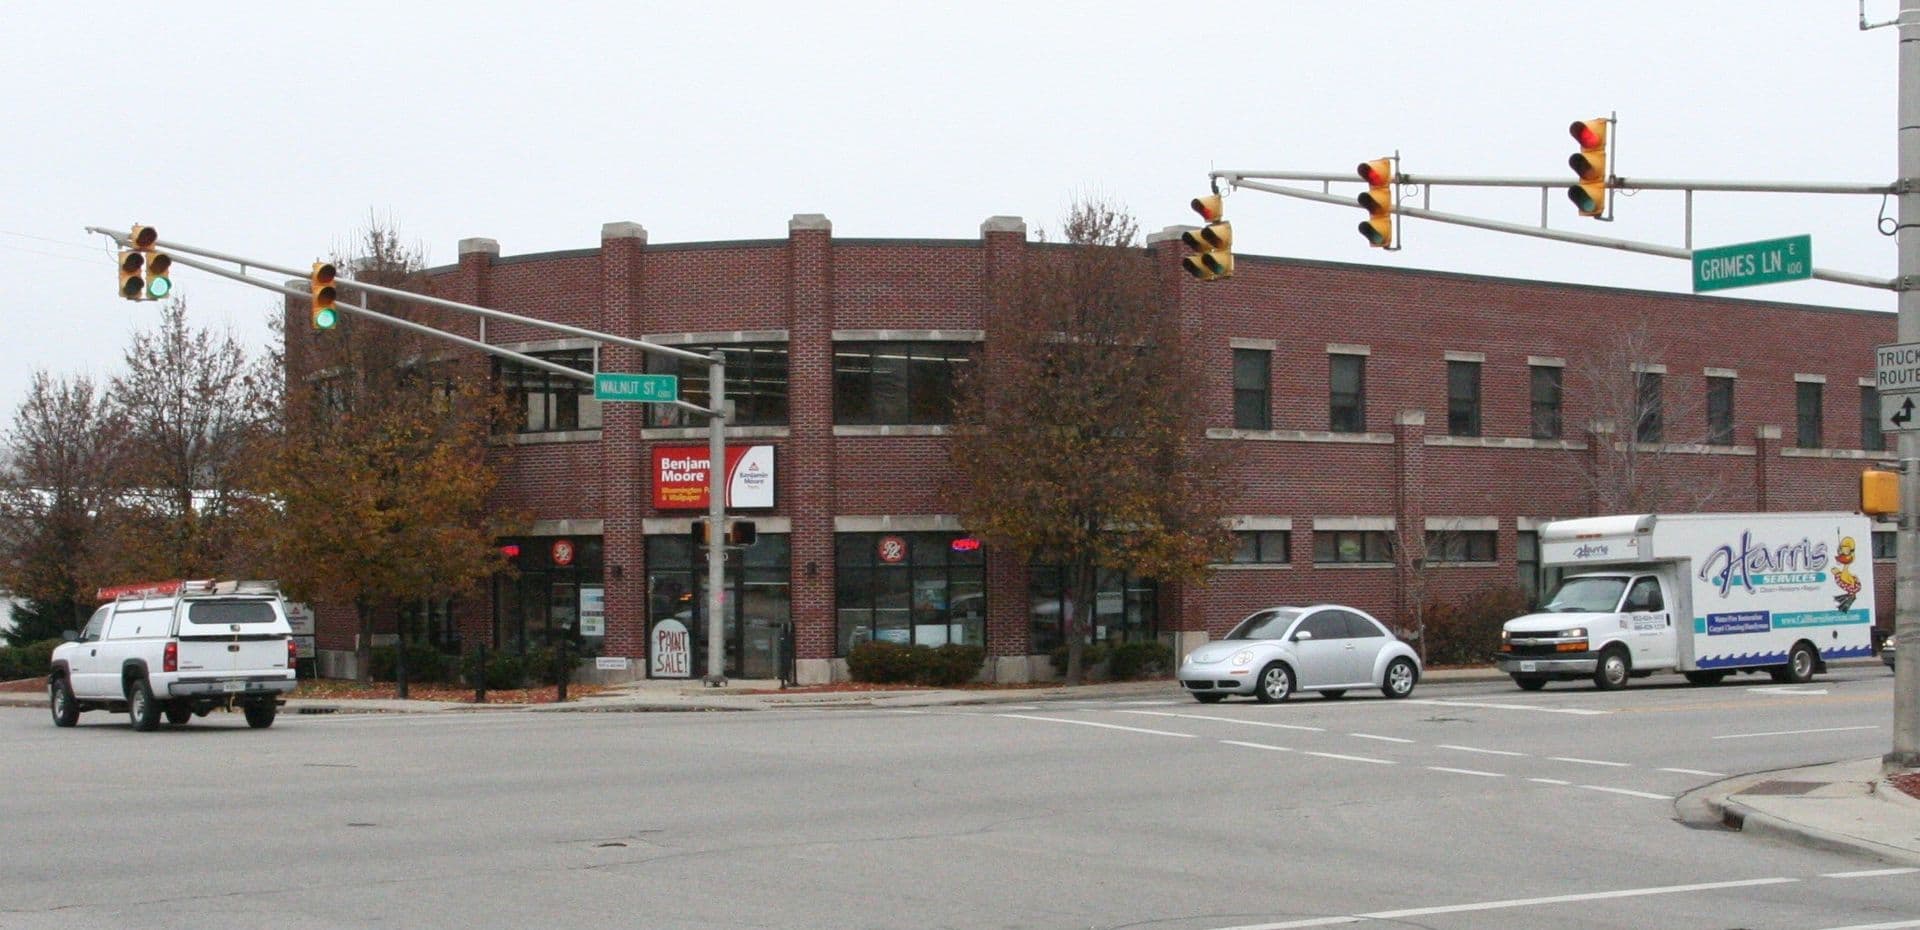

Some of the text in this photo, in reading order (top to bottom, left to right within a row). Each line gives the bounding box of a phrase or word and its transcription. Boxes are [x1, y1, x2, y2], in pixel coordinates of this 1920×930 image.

[1789, 243, 1796, 255] E
[1701, 250, 1782, 281] GRIMES LN
[1879, 367, 1920, 386] ROUTE
[600, 381, 655, 395] WALNUT ST
[661, 456, 711, 472] Benjam
[661, 470, 704, 482] Moore
[1699, 528, 1829, 598] Harris
[1763, 573, 1817, 585] SERVICES
[658, 630, 687, 652] PAINT
[655, 652, 688, 673] SALE!
